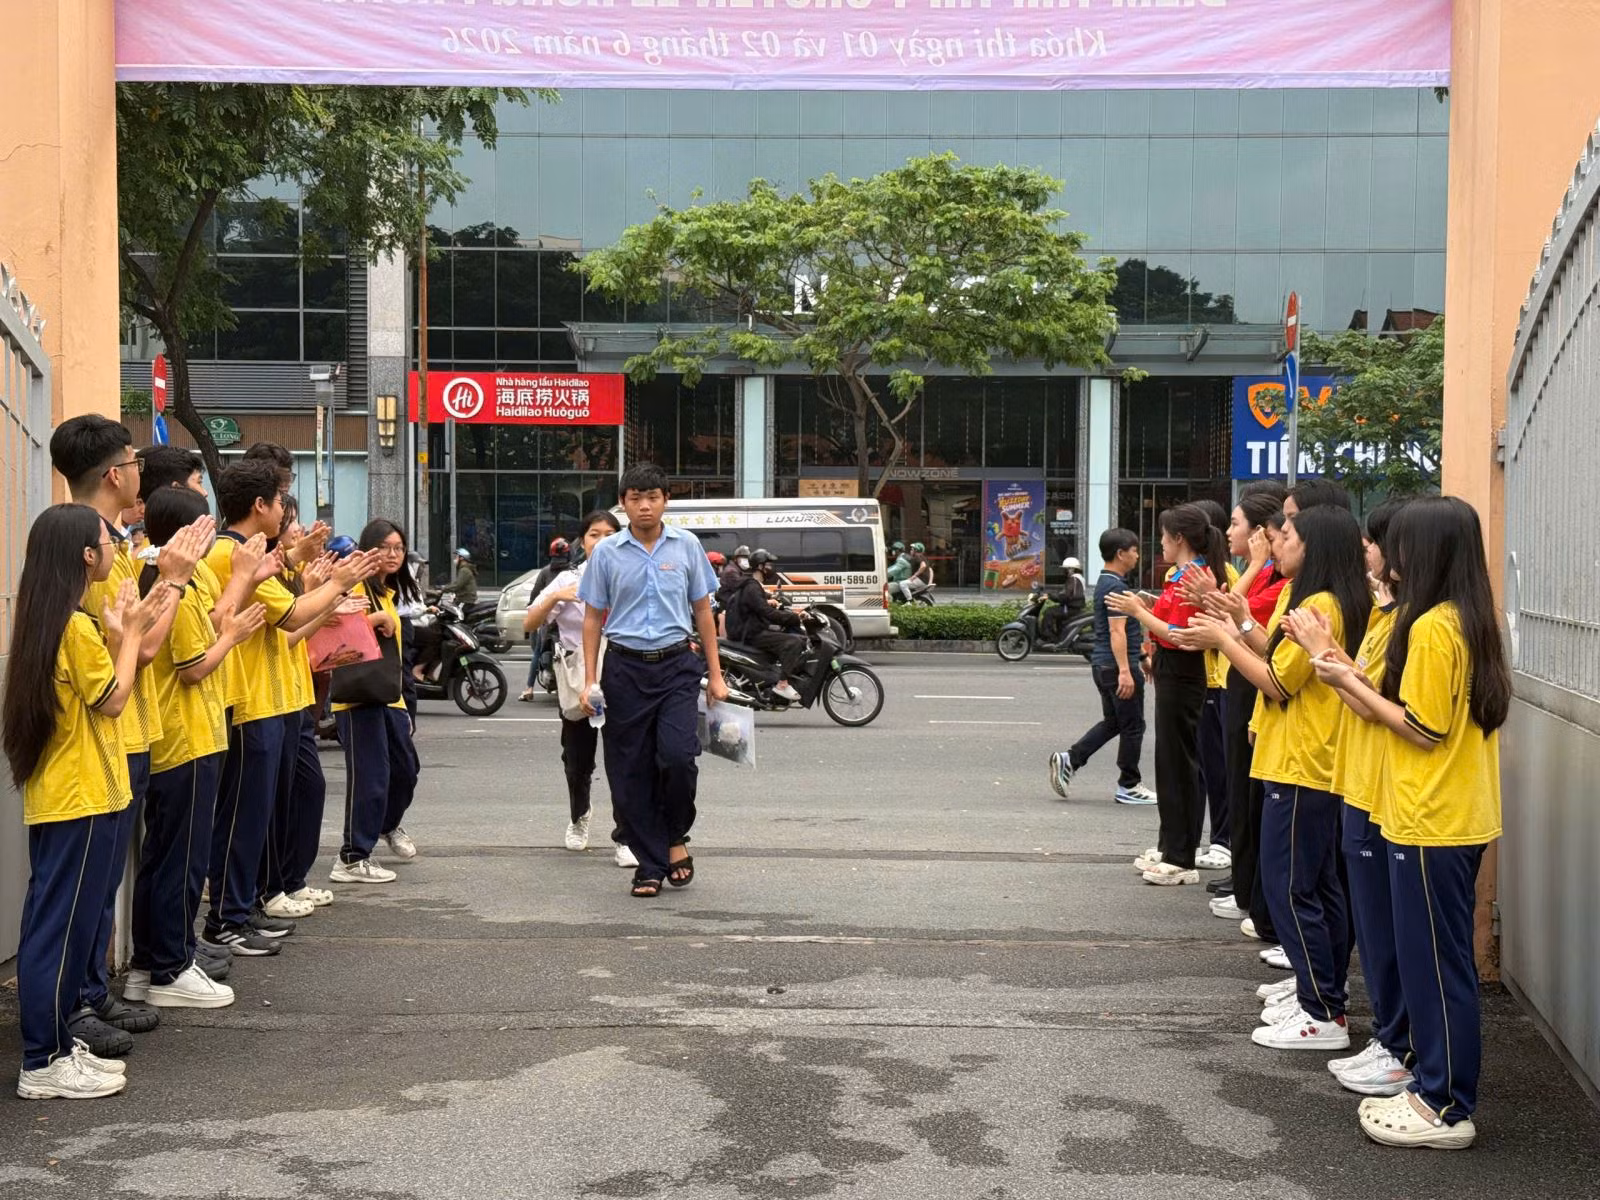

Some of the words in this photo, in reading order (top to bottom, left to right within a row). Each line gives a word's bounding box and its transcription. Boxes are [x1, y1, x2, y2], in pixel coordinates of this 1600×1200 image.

[496, 378, 514, 387] Nhà
[515, 378, 538, 389] hàng
[554, 378, 590, 388] Haidilao
[496, 388, 590, 407] 海底捞火锅
[496, 406, 542, 417] Haidilao
[890, 469, 959, 478] NOWZONE
[766, 513, 825, 523] LUXURY
[824, 575, 878, 584] 50H-589.60
